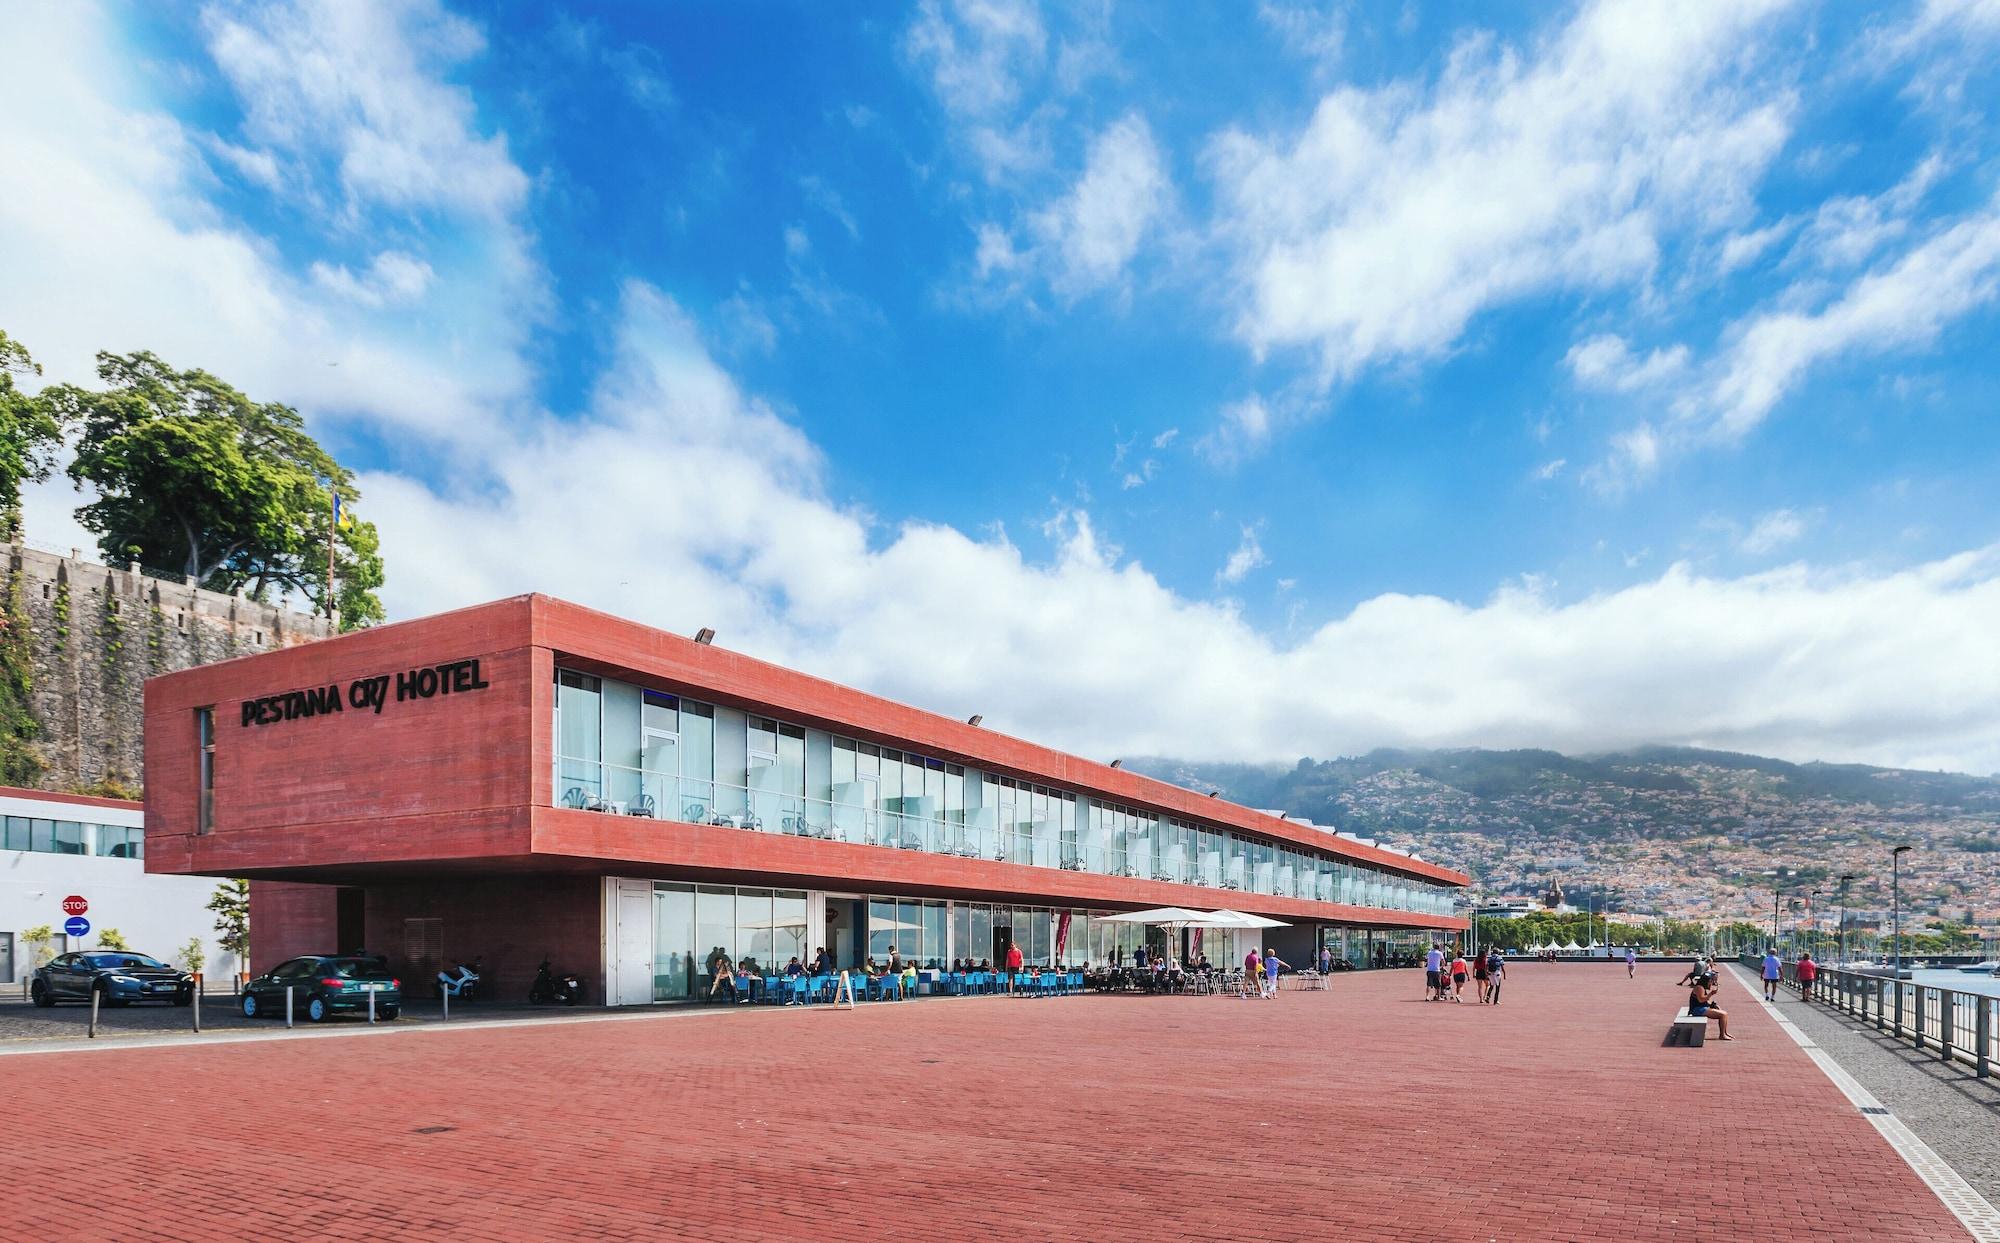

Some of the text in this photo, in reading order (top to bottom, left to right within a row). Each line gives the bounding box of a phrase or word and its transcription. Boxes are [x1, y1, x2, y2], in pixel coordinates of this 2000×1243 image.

[242, 660, 488, 727] PESTANA CR7 HOTEL
[64, 902, 87, 910] STOP
